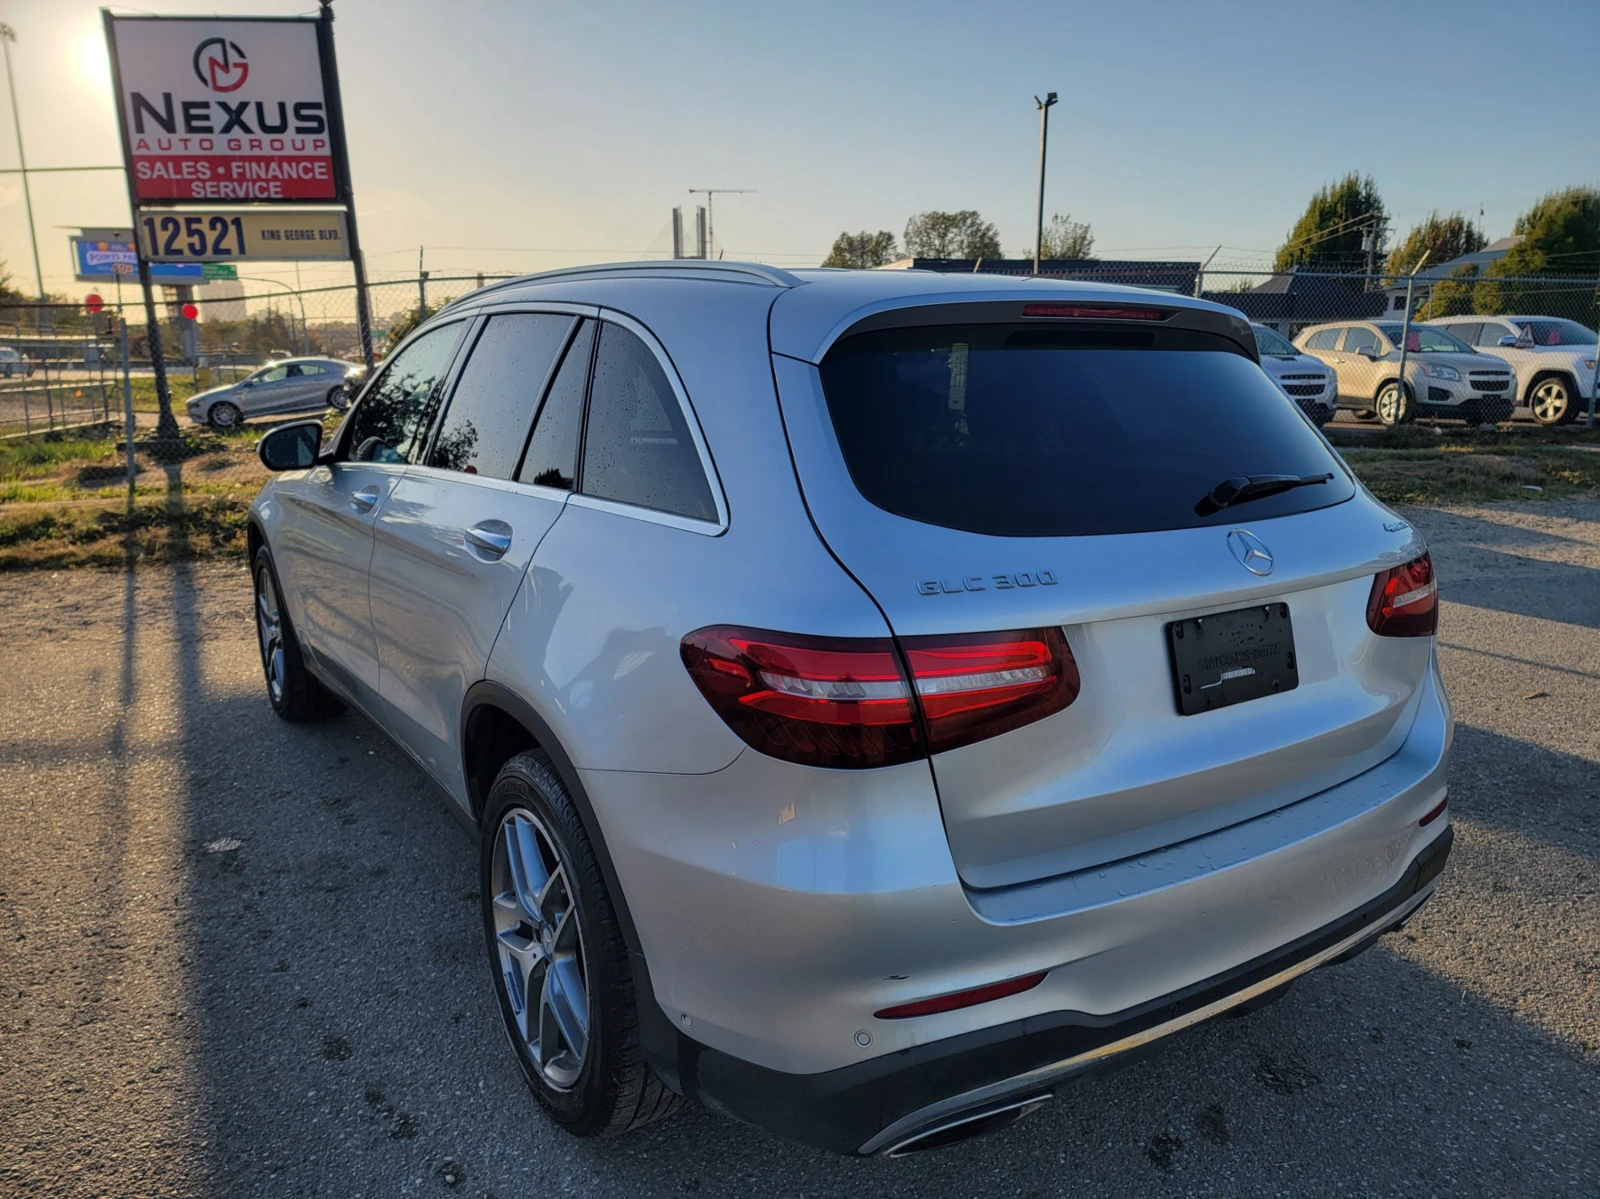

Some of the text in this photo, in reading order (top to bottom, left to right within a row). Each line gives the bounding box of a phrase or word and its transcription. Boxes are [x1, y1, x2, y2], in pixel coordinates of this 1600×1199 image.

[130, 92, 325, 134] NEXUS
[136, 138, 326, 151] AUTO GROUP
[136, 161, 329, 179] SALES FINANCE
[190, 181, 283, 198] SERVICE
[143, 216, 246, 256] 12521
[260, 229, 342, 241] KING GEORGE BLVD.
[916, 570, 1060, 596] GLC 300
